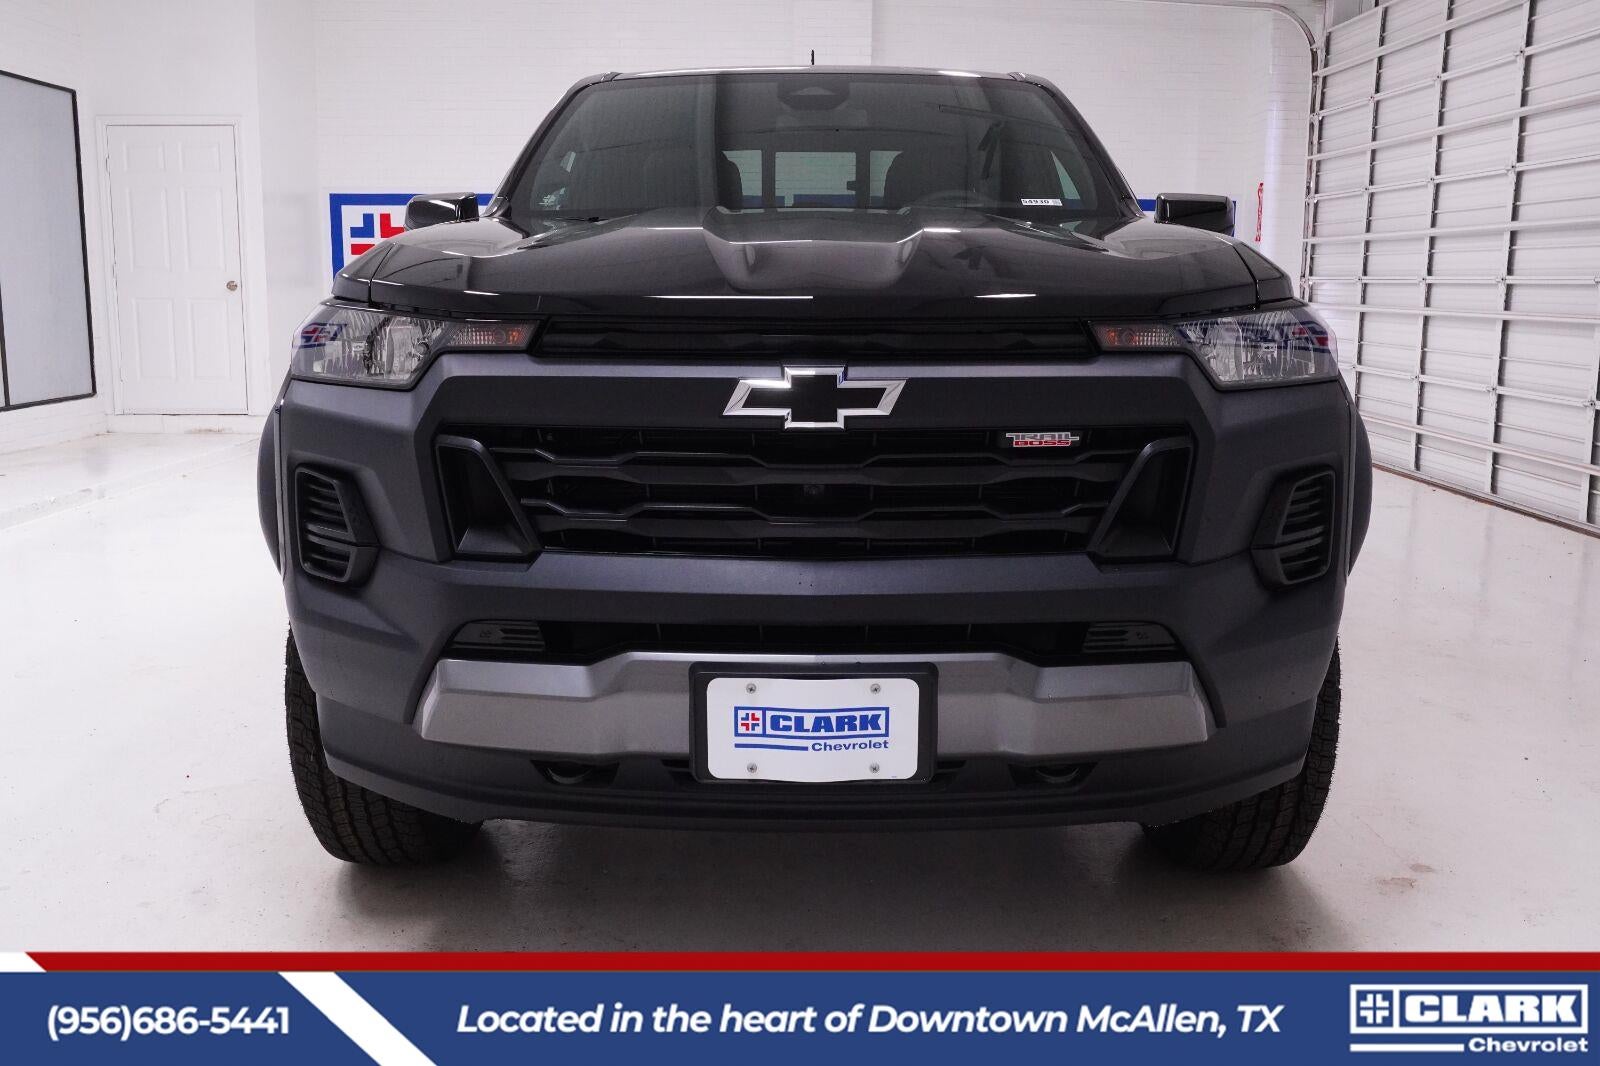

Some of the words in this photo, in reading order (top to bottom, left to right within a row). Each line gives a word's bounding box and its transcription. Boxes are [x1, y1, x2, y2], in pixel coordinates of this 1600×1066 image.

[1006, 432, 1080, 441] TRAIL
[770, 713, 882, 733] CLARK
[811, 740, 889, 752] Chevrolet
